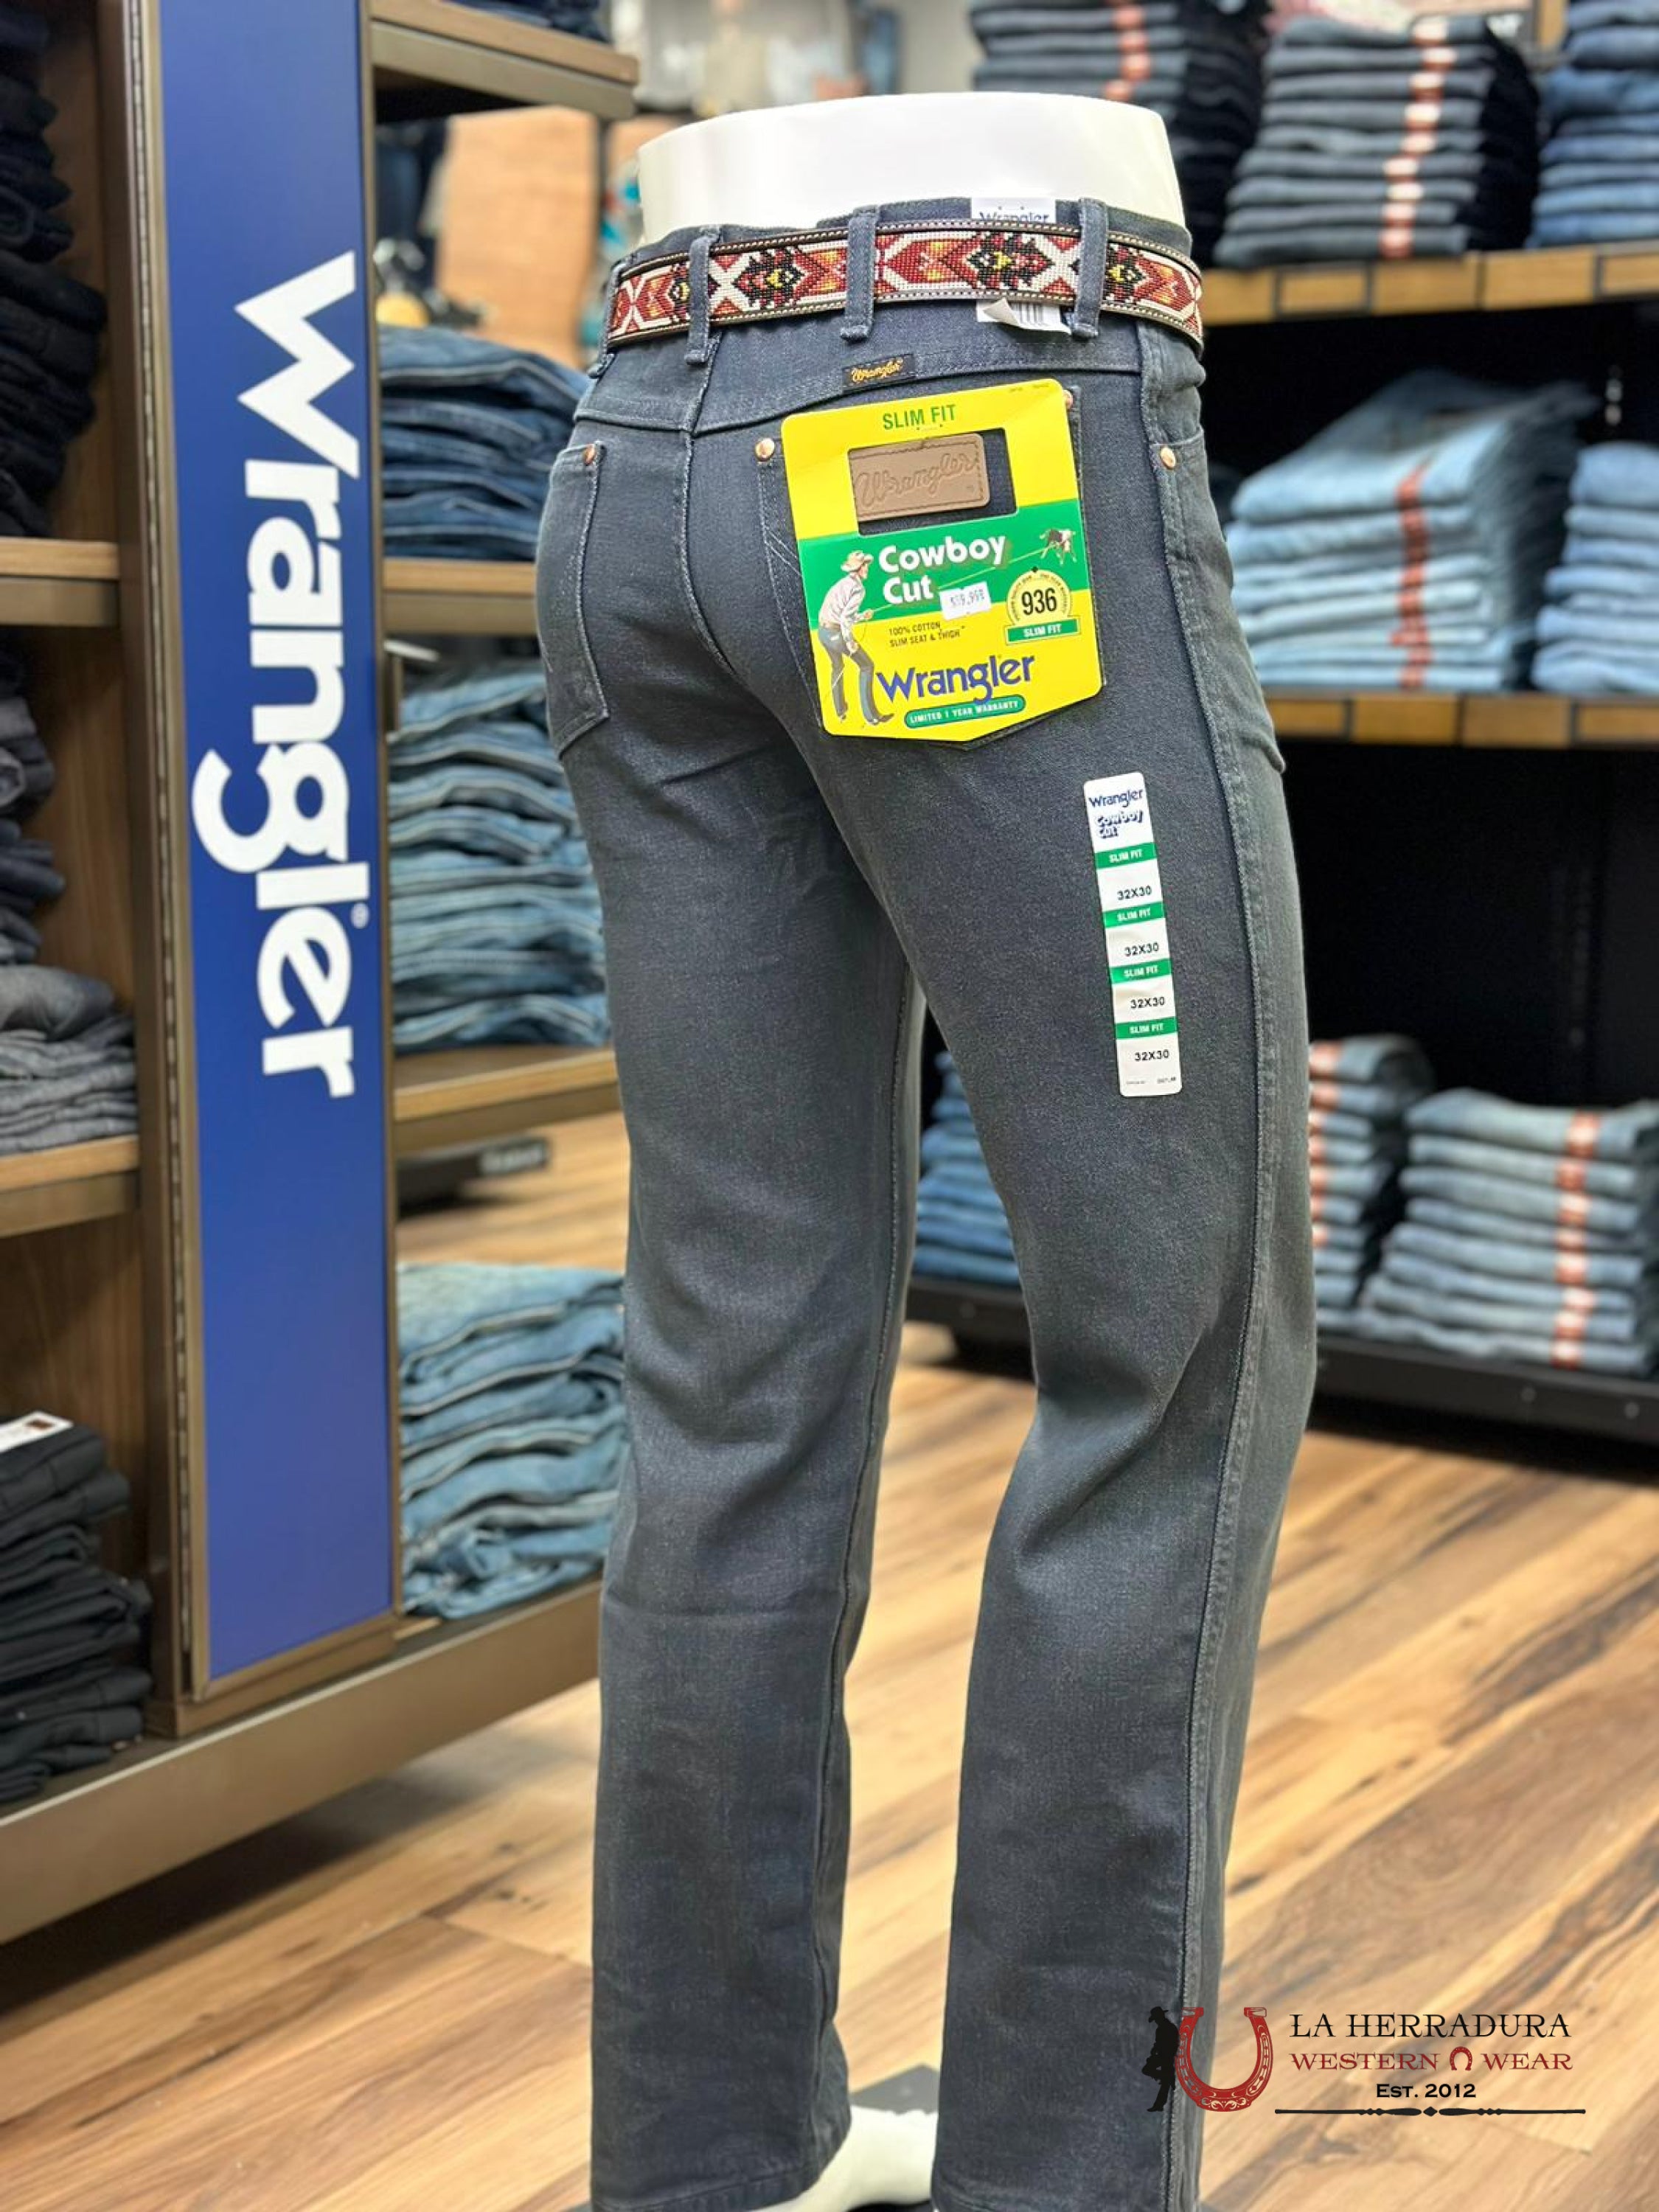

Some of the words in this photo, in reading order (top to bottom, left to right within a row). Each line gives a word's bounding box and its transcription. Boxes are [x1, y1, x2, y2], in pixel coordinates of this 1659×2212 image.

[883, 409, 925, 431] SLIM
[931, 404, 956, 422] FIT
[857, 453, 975, 507] Wrangler
[879, 535, 1006, 573] Cowboy
[883, 575, 933, 605] Cut
[1021, 588, 1057, 616] 936
[888, 626, 911, 636] 100%
[1023, 626, 1046, 639] SLIM
[1047, 623, 1062, 634] FIT
[889, 638, 908, 647] SLIM
[910, 634, 927, 644] SEAT
[192, 251, 370, 1098] Wrangler
[875, 655, 1035, 706] Wrangler
[909, 711, 942, 724] LIMITED
[952, 706, 973, 717] YEAR
[975, 700, 1019, 714] WARRANTY
[1088, 789, 1143, 808] Wrangler
[1096, 810, 1144, 827] Cowboy
[1109, 851, 1129, 863] SLIM
[1130, 849, 1142, 859] FIT
[1117, 885, 1152, 900] 32X30
[1117, 911, 1137, 922] SLIM
[1138, 908, 1151, 918] FIT
[1124, 942, 1159, 956] 32X30
[1124, 967, 1144, 977] SLIM
[1145, 964, 1158, 974] FIT
[1130, 996, 1166, 1009] 32X30
[1129, 1025, 1150, 1034] SLIM
[1151, 1023, 1164, 1032] FIT
[1135, 1049, 1169, 1062] 32X30
